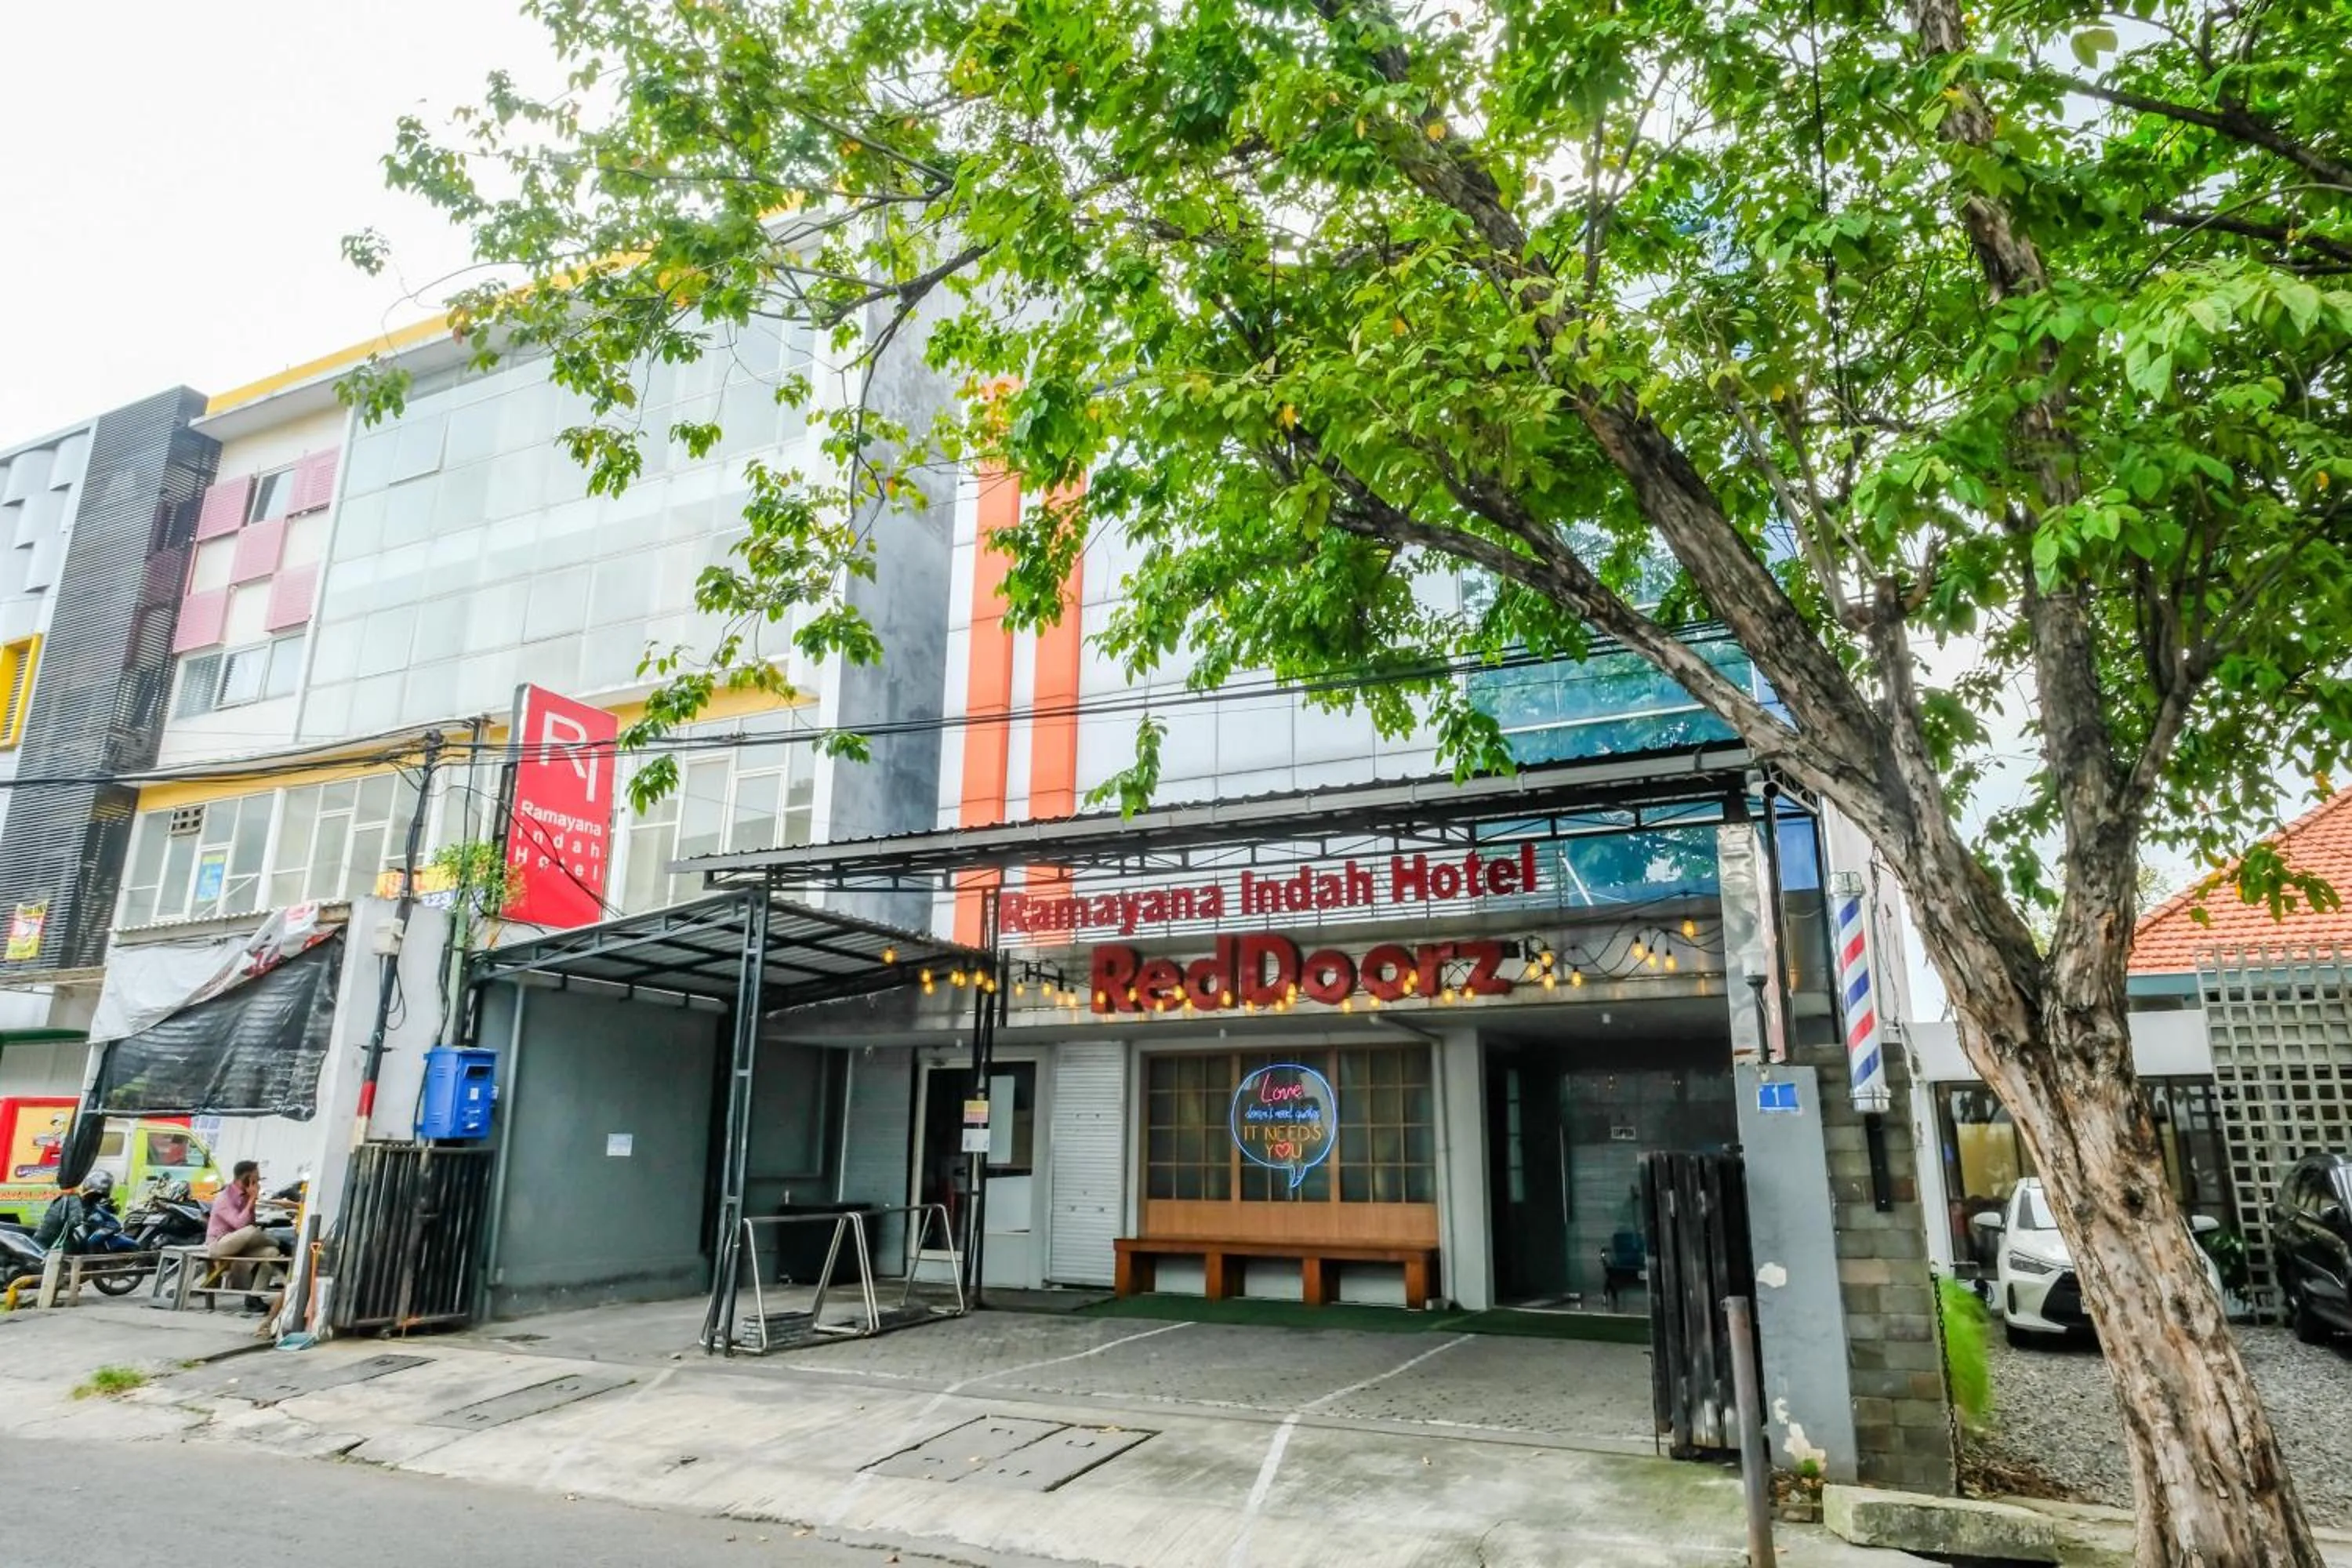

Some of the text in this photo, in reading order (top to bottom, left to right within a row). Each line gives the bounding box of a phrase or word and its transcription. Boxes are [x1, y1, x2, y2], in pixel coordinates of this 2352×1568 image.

[521, 800, 602, 837] Ramayana
[999, 841, 1537, 935] Ramayana Indah Hotel
[1091, 933, 1513, 1014] RedDoorz
[1260, 1073, 1304, 1103] Love
[1244, 1125, 1322, 1142] IT NEEDS
